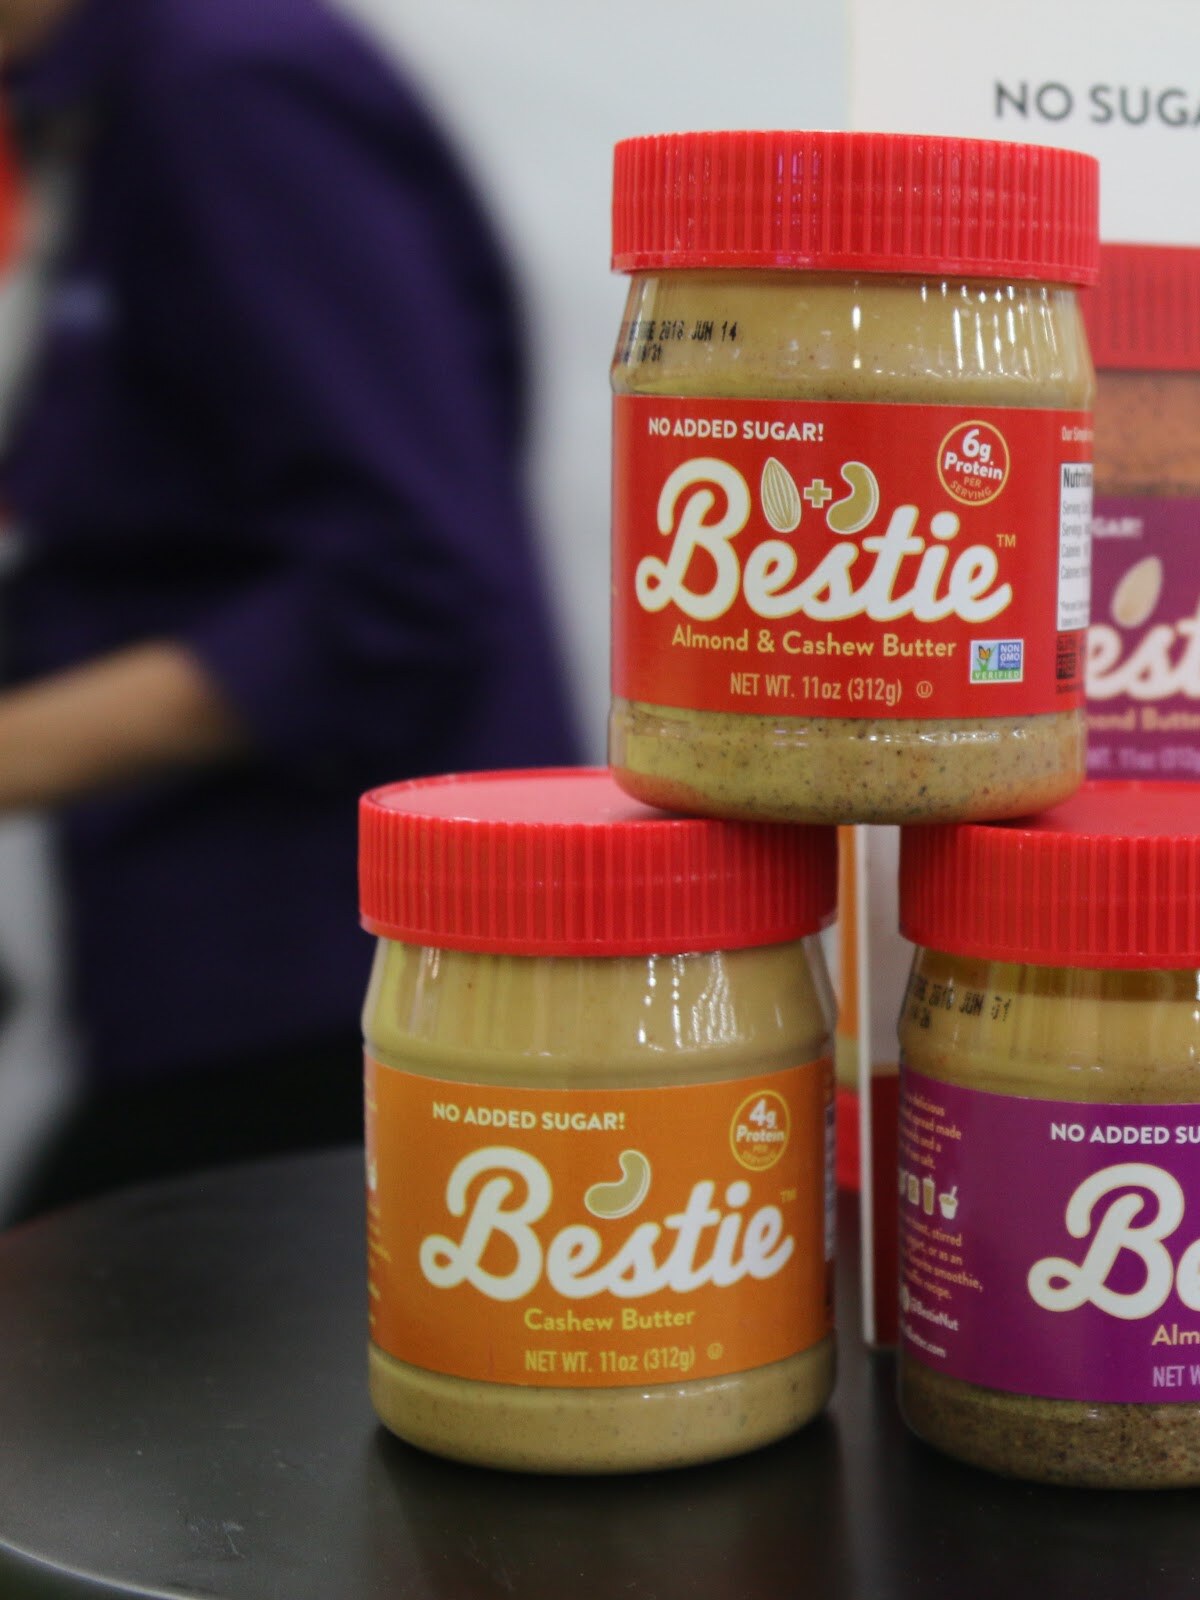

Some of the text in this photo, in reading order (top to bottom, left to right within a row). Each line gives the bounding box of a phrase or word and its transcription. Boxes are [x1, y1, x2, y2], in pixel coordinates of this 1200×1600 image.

[995, 81, 1074, 122] NO
[691, 319, 714, 341] JUN
[721, 321, 738, 341] 14
[649, 417, 825, 442] NO ADDED SUGAR!
[962, 428, 992, 463] 6g
[944, 451, 1004, 480] Protein
[950, 480, 993, 500] SERVING
[963, 476, 983, 488] PER
[635, 456, 1013, 623] Bestie
[672, 624, 957, 657] Almond & Cashew Butter
[1000, 643, 1020, 652] NON
[1000, 653, 1020, 662] GMO
[973, 670, 1020, 680] VERIFIED
[730, 672, 902, 707] NET WT. 11oz (312g)
[432, 1101, 626, 1131] NO ADDED SUGAR!
[749, 1098, 777, 1130] 4g
[736, 1124, 785, 1143] Protein
[936, 1124, 962, 1141] made
[1051, 1122, 1085, 1143] NO
[1089, 1125, 1170, 1145] ADDED
[419, 1145, 795, 1301] Bestie
[932, 1227, 962, 1248] stirred
[950, 1255, 963, 1266] an
[933, 1267, 984, 1293] smoothie,
[524, 1307, 697, 1332] Cashew Butter
[525, 1345, 697, 1374] NET WT. 11oz (312g)
[1153, 1365, 1185, 1388] NET
